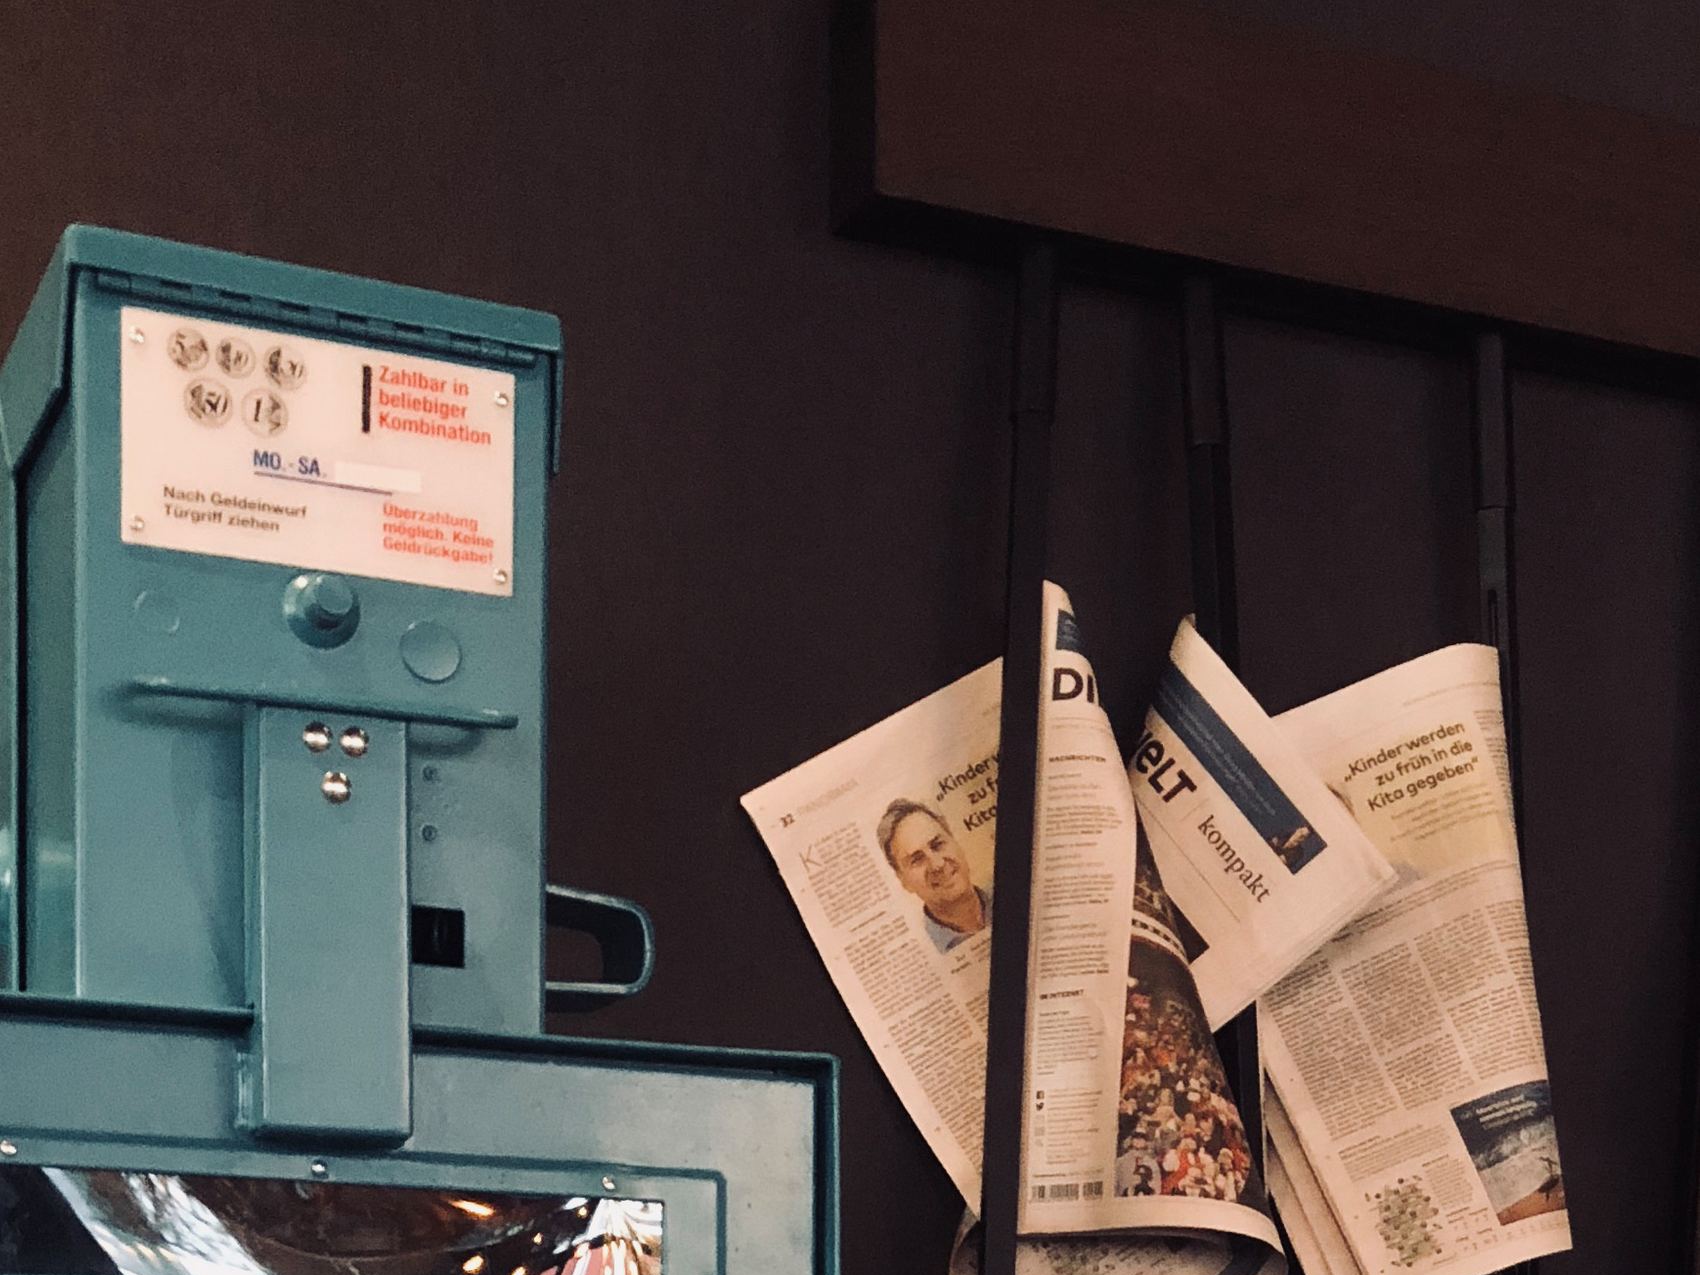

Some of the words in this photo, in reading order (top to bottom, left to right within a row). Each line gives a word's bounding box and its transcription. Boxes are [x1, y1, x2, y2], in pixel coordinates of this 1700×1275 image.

[379, 365, 447, 393] Zahlbar
[453, 379, 469, 396] in
[379, 389, 468, 420] beliebiger
[379, 411, 492, 445] Kombination
[163, 486, 206, 503] Nach
[210, 492, 307, 518] Geldeinwurf
[164, 503, 223, 524] Türgriff
[228, 515, 280, 532] ziehen
[383, 502, 478, 533] Überzahlung
[452, 530, 494, 548] Keine
[1405, 723, 1465, 751] werden
[1375, 770, 1395, 787] zu
[1396, 754, 1433, 777] früh
[1431, 749, 1448, 763] in
[1450, 740, 1473, 756] die
[967, 787, 987, 805] zu
[1367, 789, 1405, 812] Kita
[1198, 814, 1272, 903] kompakt
